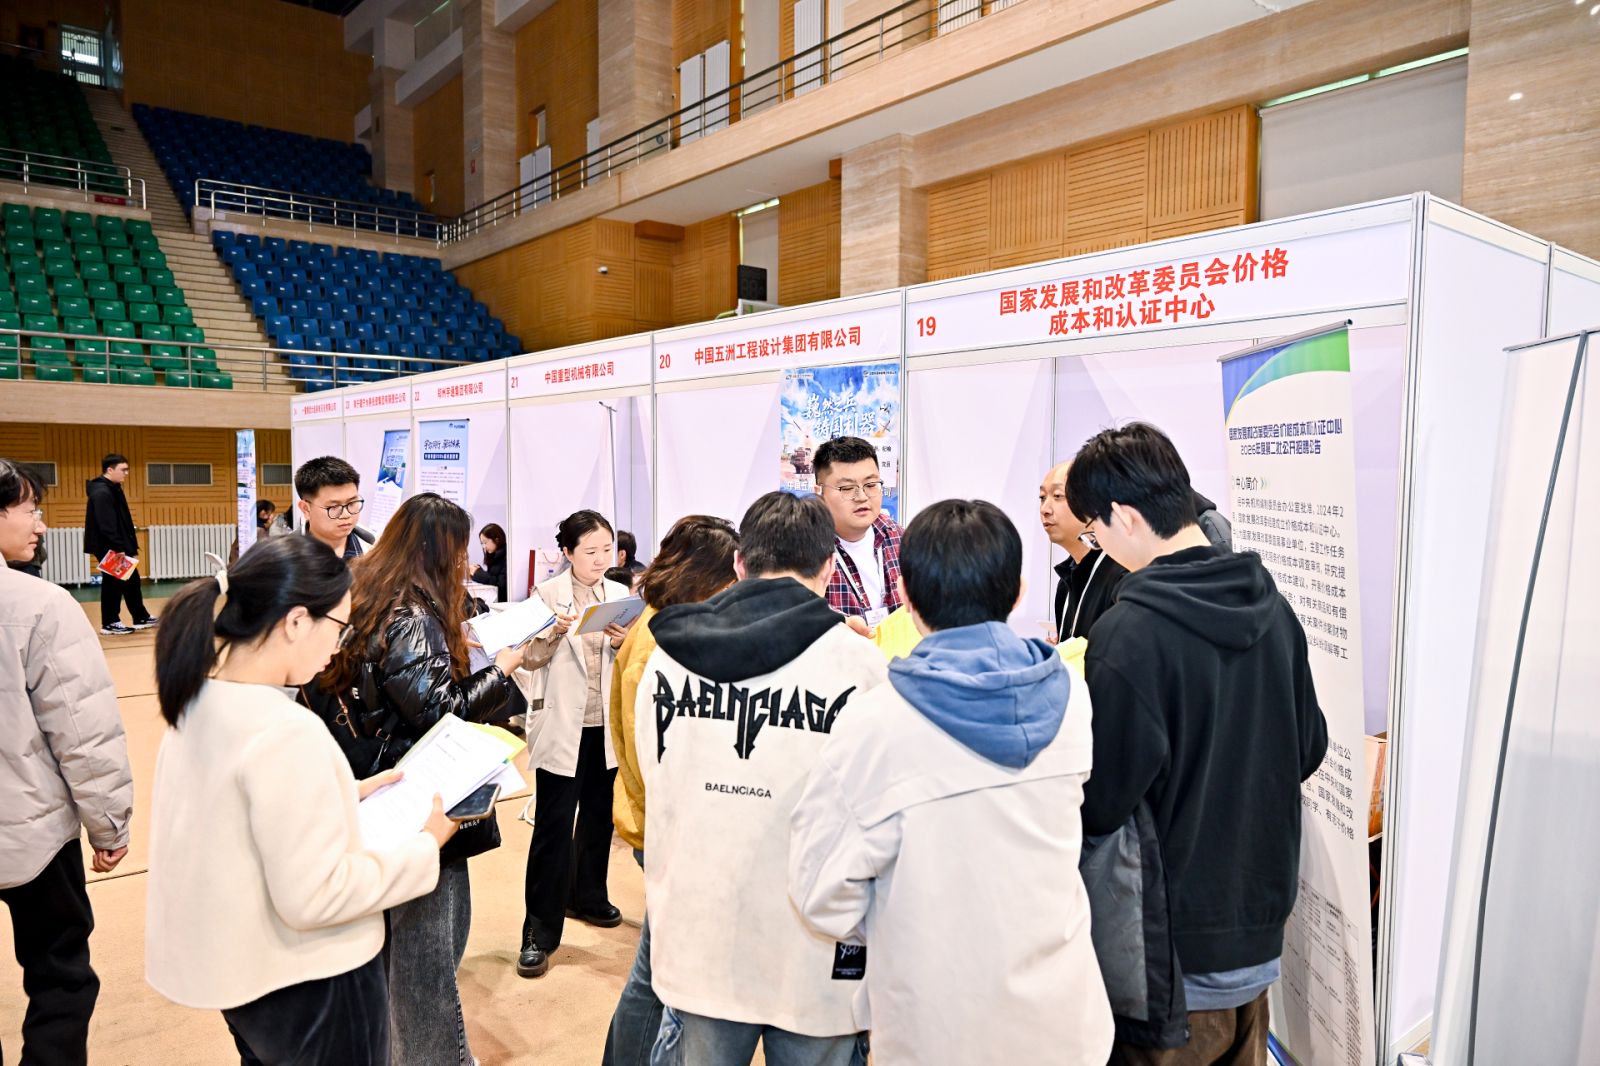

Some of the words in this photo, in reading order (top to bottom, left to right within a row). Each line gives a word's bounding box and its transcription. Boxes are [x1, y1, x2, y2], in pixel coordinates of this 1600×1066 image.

[1000, 247, 1289, 316] 国家发展和改革委员会价格
[1049, 293, 1216, 336] 成本和认证中心
[916, 317, 937, 338] 19
[694, 326, 861, 366] 中国五洲工程设计集团有限公司
[659, 353, 671, 369] 20
[511, 377, 519, 389] 21
[544, 361, 614, 384] 中国重型机械有限公司
[1235, 477, 1259, 491] 中心简介
[704, 782, 773, 799] BAELNCIAGA
